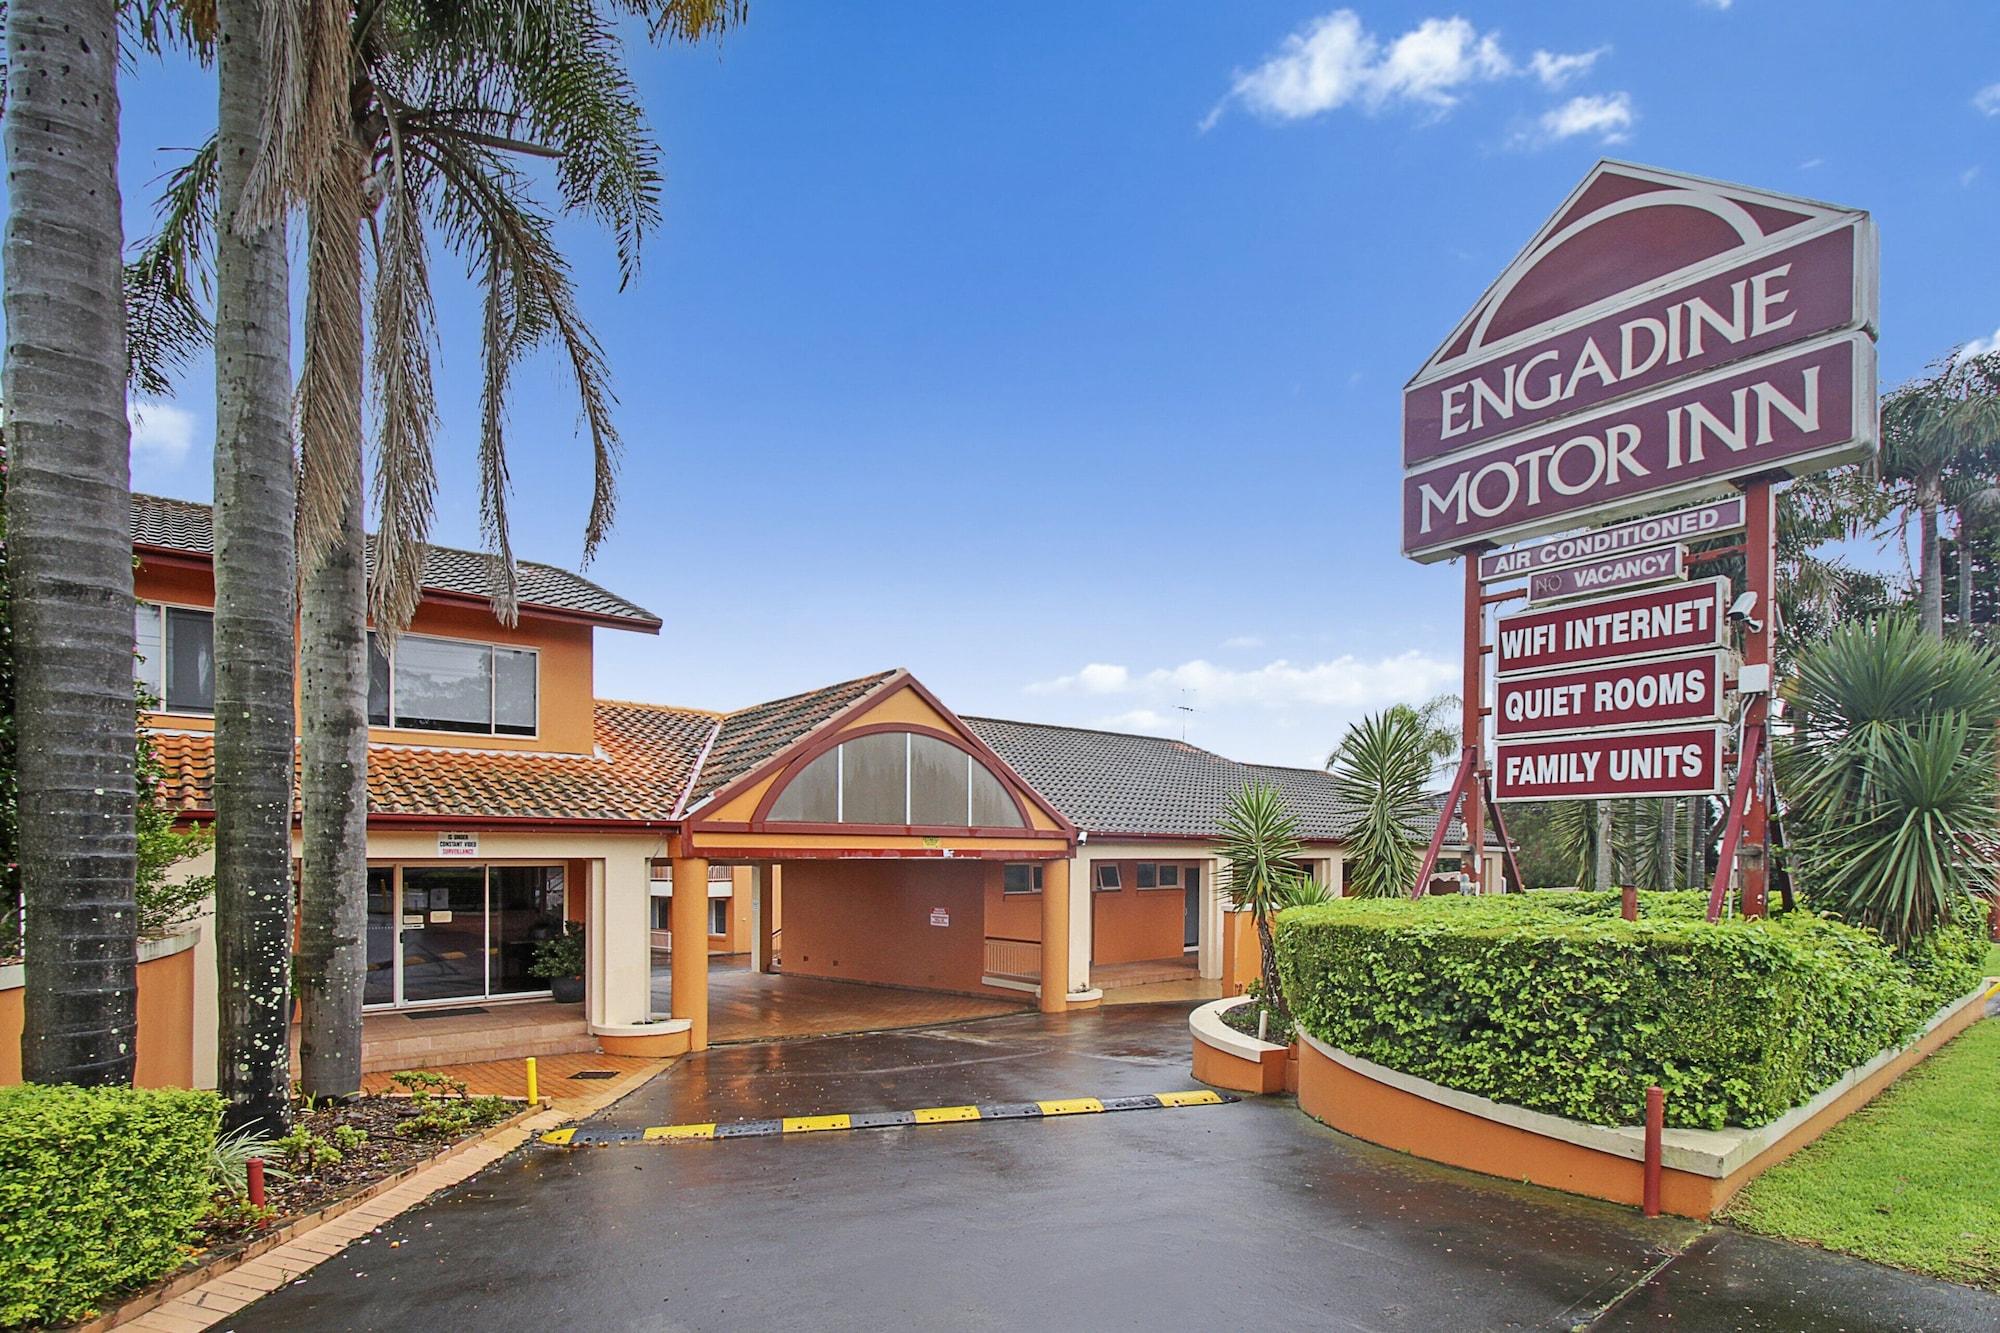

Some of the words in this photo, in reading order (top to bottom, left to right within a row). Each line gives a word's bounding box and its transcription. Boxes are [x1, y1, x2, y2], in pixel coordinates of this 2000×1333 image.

[1440, 263, 1798, 441] ENGADINE
[1418, 423, 1652, 536] MOTOR
[1666, 365, 1822, 470] INN
[1494, 549, 1532, 574] AIR
[1539, 509, 1719, 564] CONDITIONED
[1535, 574, 1563, 594] NO
[1573, 553, 1672, 588] VACANCY
[1501, 623, 1557, 660] WIFI
[1564, 596, 1714, 651] INTERNET
[1504, 684, 1587, 723] QUIET
[1594, 669, 1706, 713] ROOMS
[1506, 750, 1602, 786] FAMILY
[1609, 743, 1703, 779] UNITS
